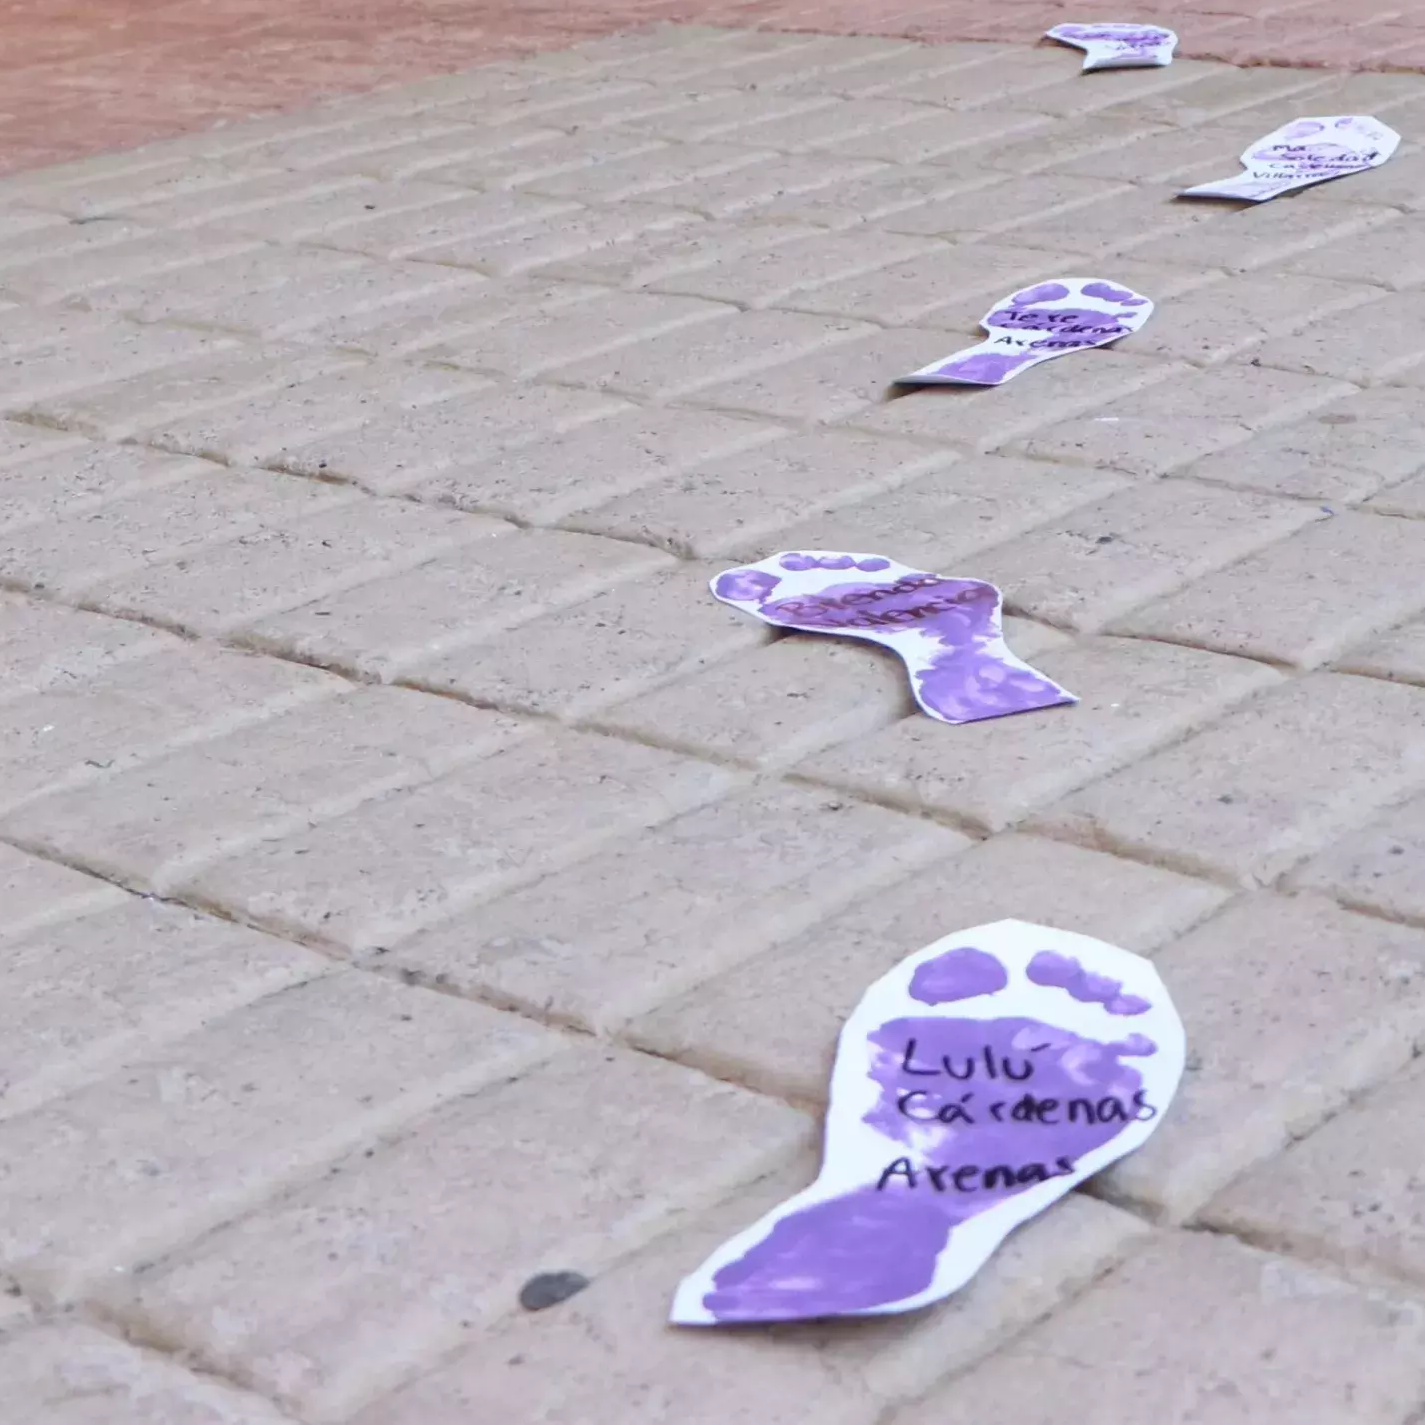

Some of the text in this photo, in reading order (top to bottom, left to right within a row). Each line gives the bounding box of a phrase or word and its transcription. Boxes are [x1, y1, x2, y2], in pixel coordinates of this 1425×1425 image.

[901, 1038, 1052, 1080] Lulú
[897, 1089, 1159, 1125] Cárdenas
[877, 1156, 1076, 1192] Arenas
